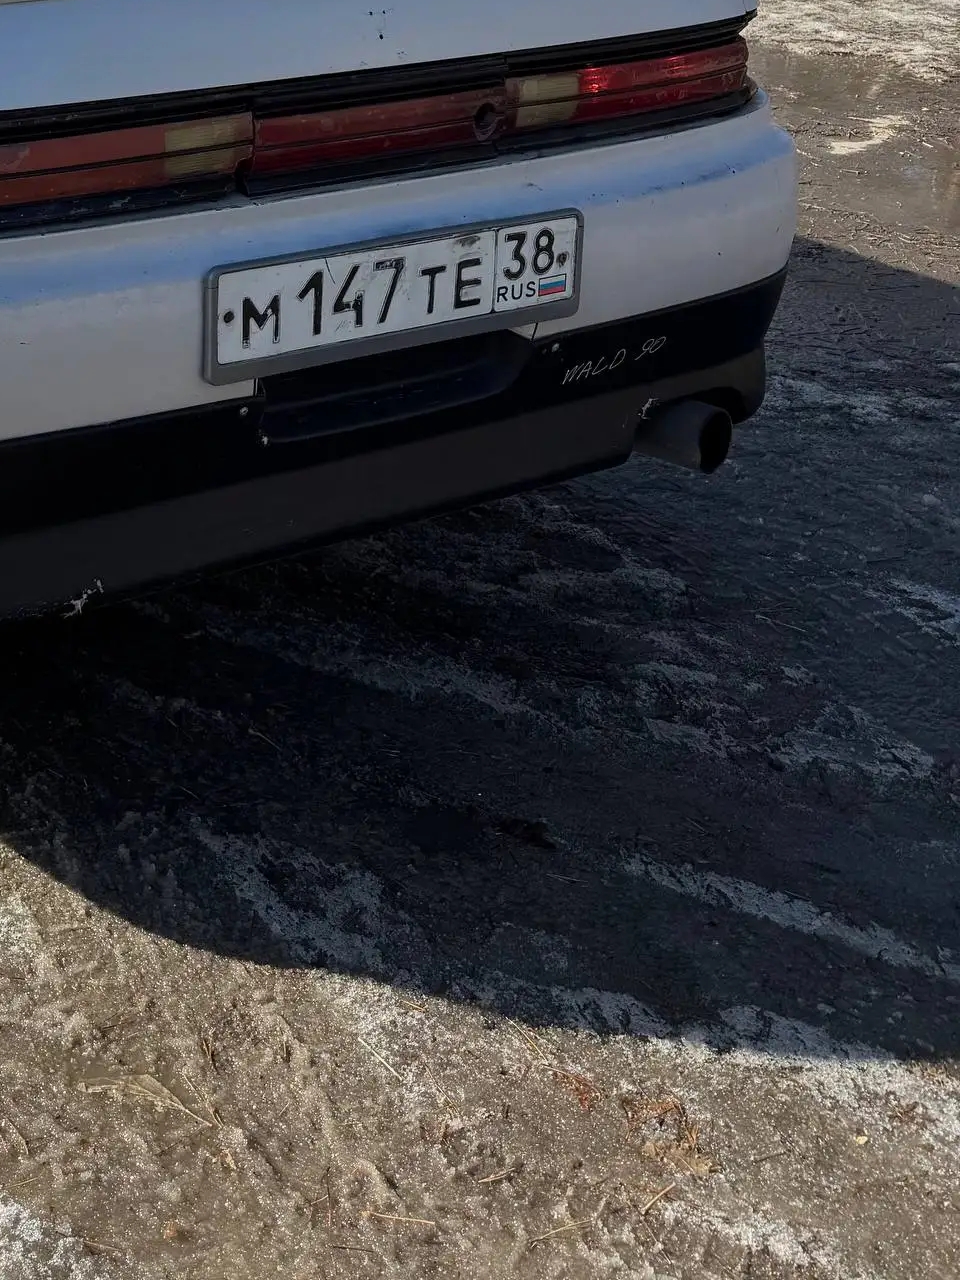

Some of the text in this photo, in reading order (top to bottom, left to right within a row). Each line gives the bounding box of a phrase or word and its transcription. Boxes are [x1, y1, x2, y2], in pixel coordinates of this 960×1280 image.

[503, 228, 555, 280] 38
[496, 281, 537, 303] RUS
[562, 349, 627, 385] WALD
